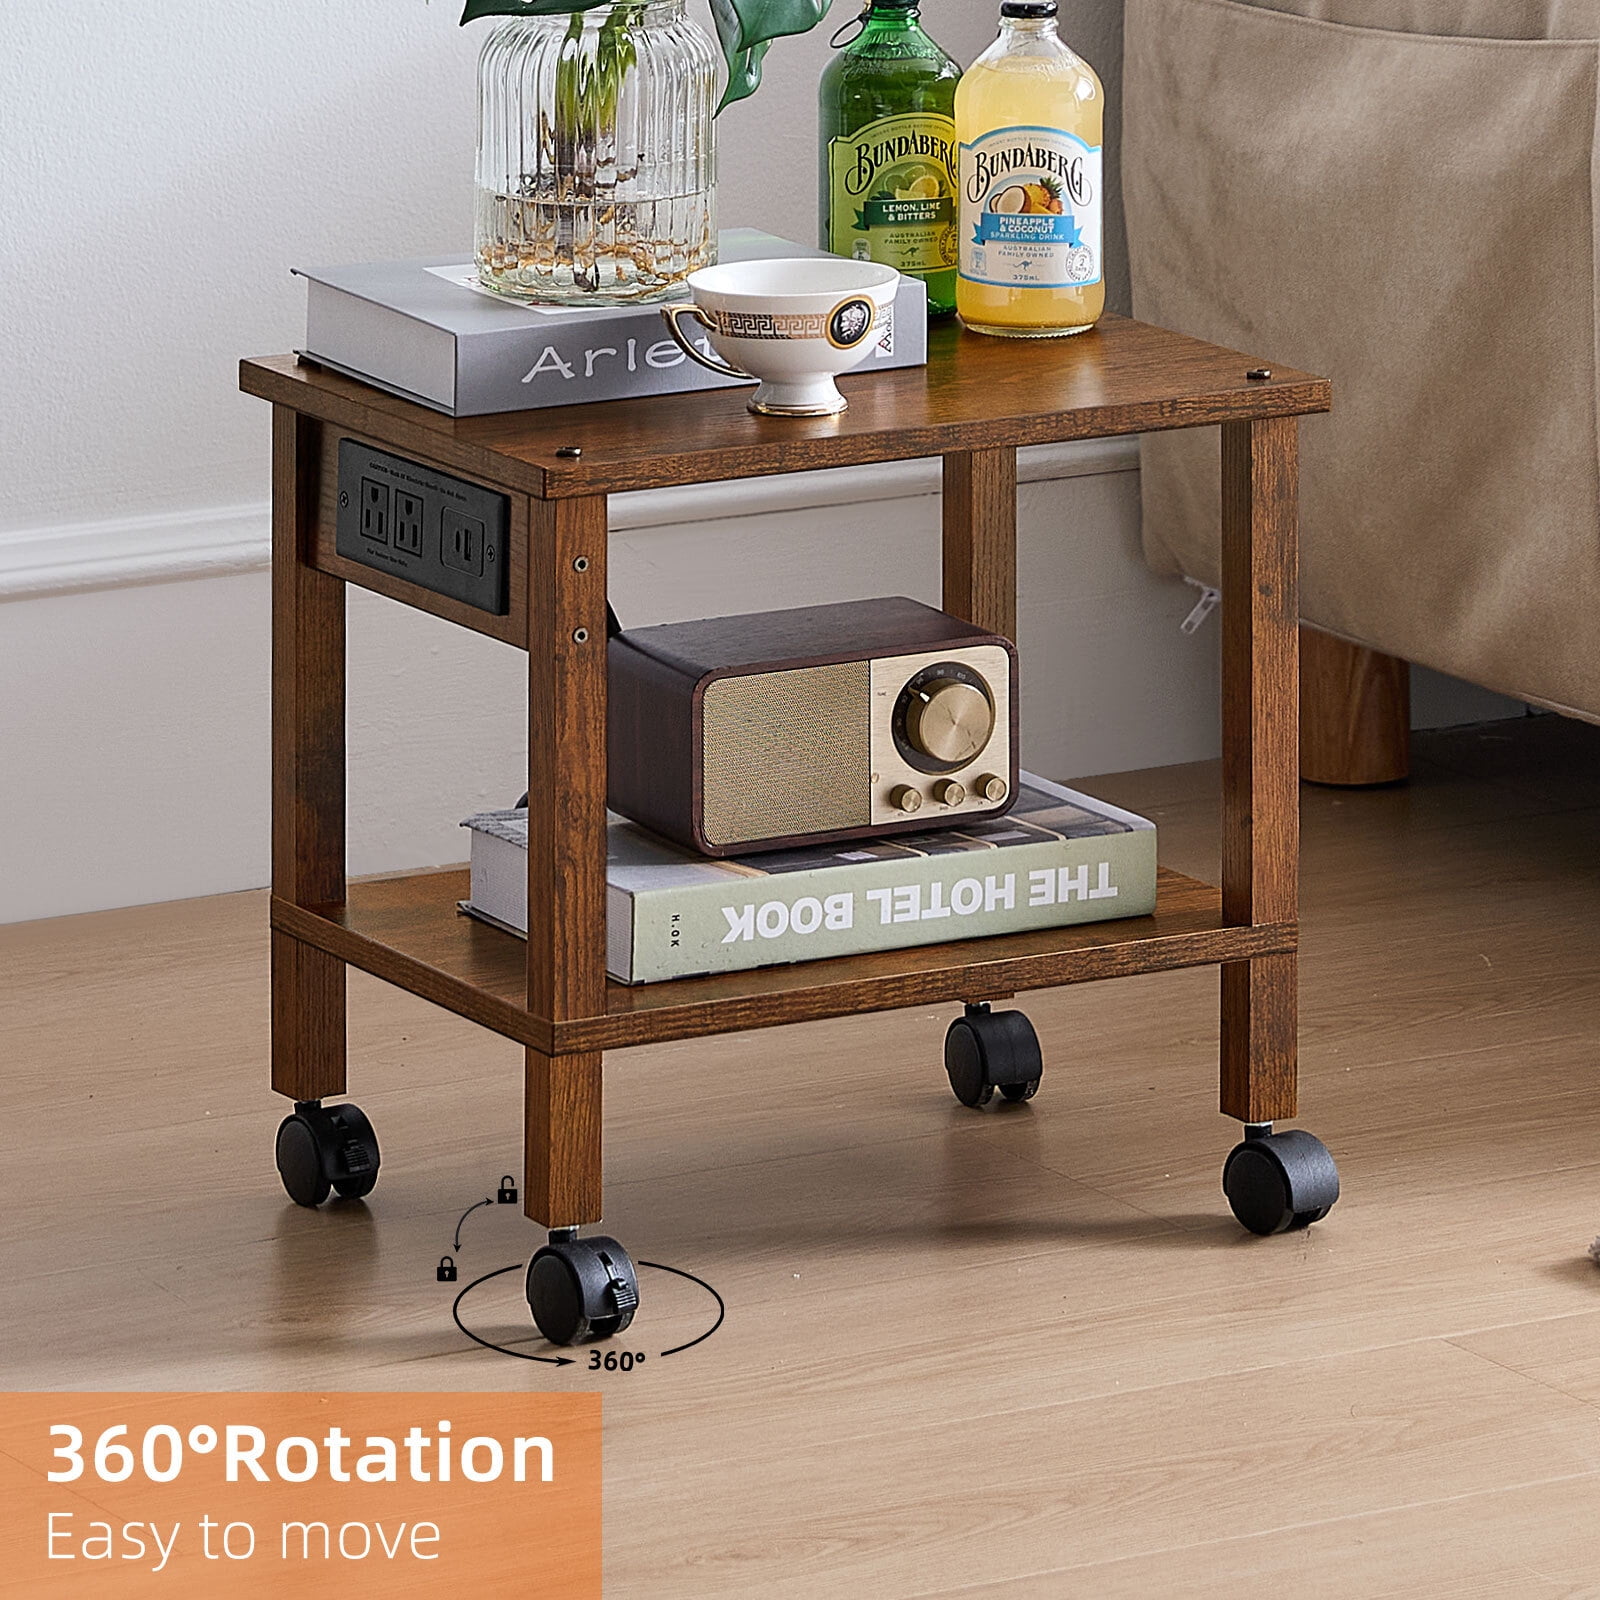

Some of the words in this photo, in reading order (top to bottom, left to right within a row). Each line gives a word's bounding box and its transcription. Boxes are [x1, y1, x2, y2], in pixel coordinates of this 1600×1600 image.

[967, 142, 1093, 207] BUNDABERG
[921, 201, 941, 210] LIME
[888, 213, 895, 221] &
[898, 211, 937, 221] BITTERS
[1000, 216, 1055, 226] PINEAPPLE
[1008, 225, 1054, 233] COCONUT
[990, 231, 1036, 239] SPARKLING
[1028, 862, 1119, 908] THE
[866, 874, 1016, 925] HOTEL
[721, 892, 854, 944] BOOK
